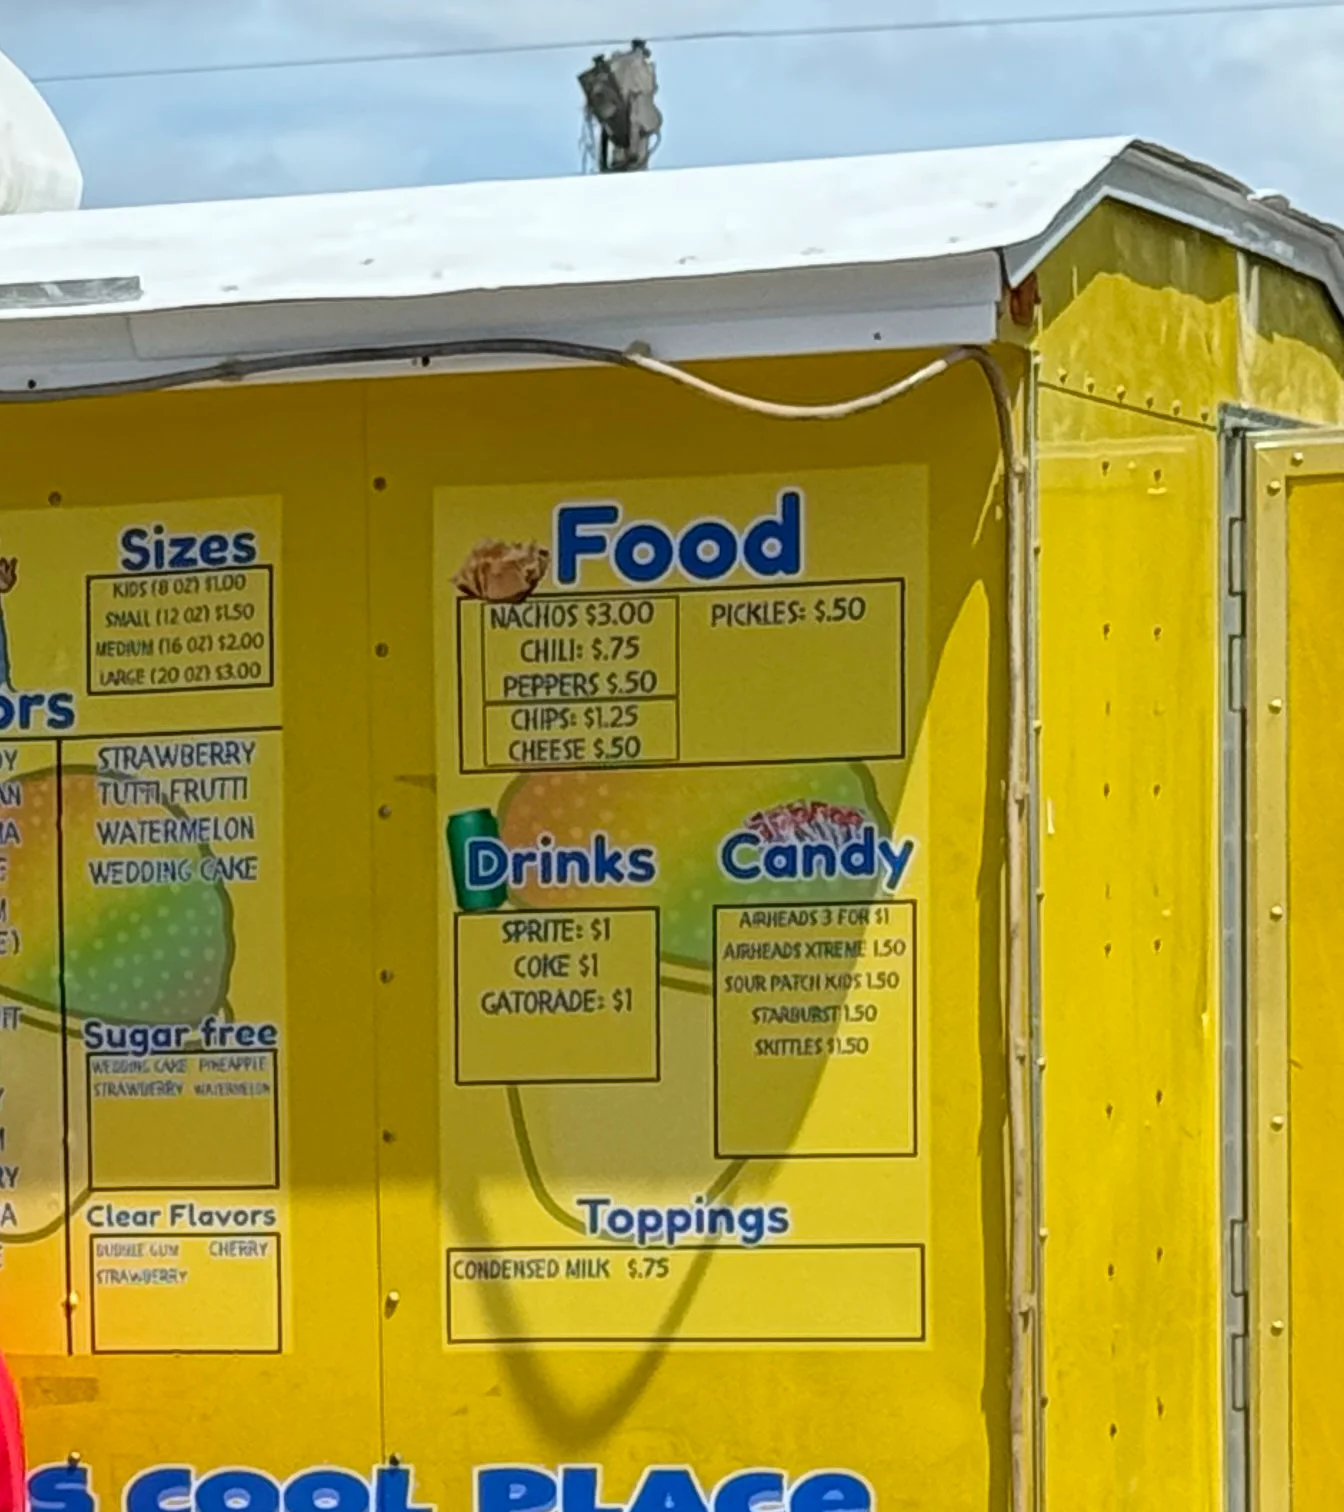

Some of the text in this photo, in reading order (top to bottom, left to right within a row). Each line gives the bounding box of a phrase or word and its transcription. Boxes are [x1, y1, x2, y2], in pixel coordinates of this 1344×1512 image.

[121, 524, 256, 571] Sizes
[557, 492, 799, 584] Food
[113, 580, 147, 598] KIDS
[152, 578, 168, 596] (8
[174, 576, 199, 594] OZ)
[106, 609, 150, 628] SMALL
[156, 608, 179, 626] (12
[184, 604, 209, 623] OZ)
[490, 601, 654, 629] NACHOS $3.00
[711, 596, 866, 627] PICKLES: $.50
[95, 632, 264, 656] MEDIUM (16 OZ) $2.00
[521, 636, 639, 663] CHILI: $.75
[100, 662, 261, 686] LARGE (20 OZ) $3.00
[504, 670, 657, 697] PEPPERS $.50
[512, 705, 638, 731] CHIPS: $1.25
[98, 741, 255, 770] STRAWBERRY
[509, 736, 641, 762] CHEESE $.50
[98, 776, 247, 806] TUTTI FRUTTI
[97, 816, 254, 845] WATERMELON
[89, 856, 257, 884] WEDDING CAKE
[469, 836, 656, 887] Drinks
[722, 833, 914, 890] Candy
[502, 917, 611, 944] SPRITE: $1
[739, 908, 889, 929] AIRHEADS 3 FOR $1
[723, 939, 906, 960] AIRHEADS XTREME 1.50
[515, 953, 598, 978] COKE $1
[725, 971, 900, 993] SOUR PATCH KIDS 1.50
[481, 987, 632, 1015] GATORADE: $1
[752, 1004, 878, 1024] STARBURST 1.50
[84, 1017, 278, 1056] Sugar free
[755, 1037, 822, 1056] SKITTLES
[93, 1080, 183, 1097] STRAWBERRY
[87, 1204, 276, 1227] Clear Flavors
[576, 1196, 790, 1246] Toppings
[209, 1241, 268, 1256] CHERRY
[96, 1269, 187, 1284] STRAWBERRY
[453, 1257, 670, 1282] CONDENSED MILK $.75
